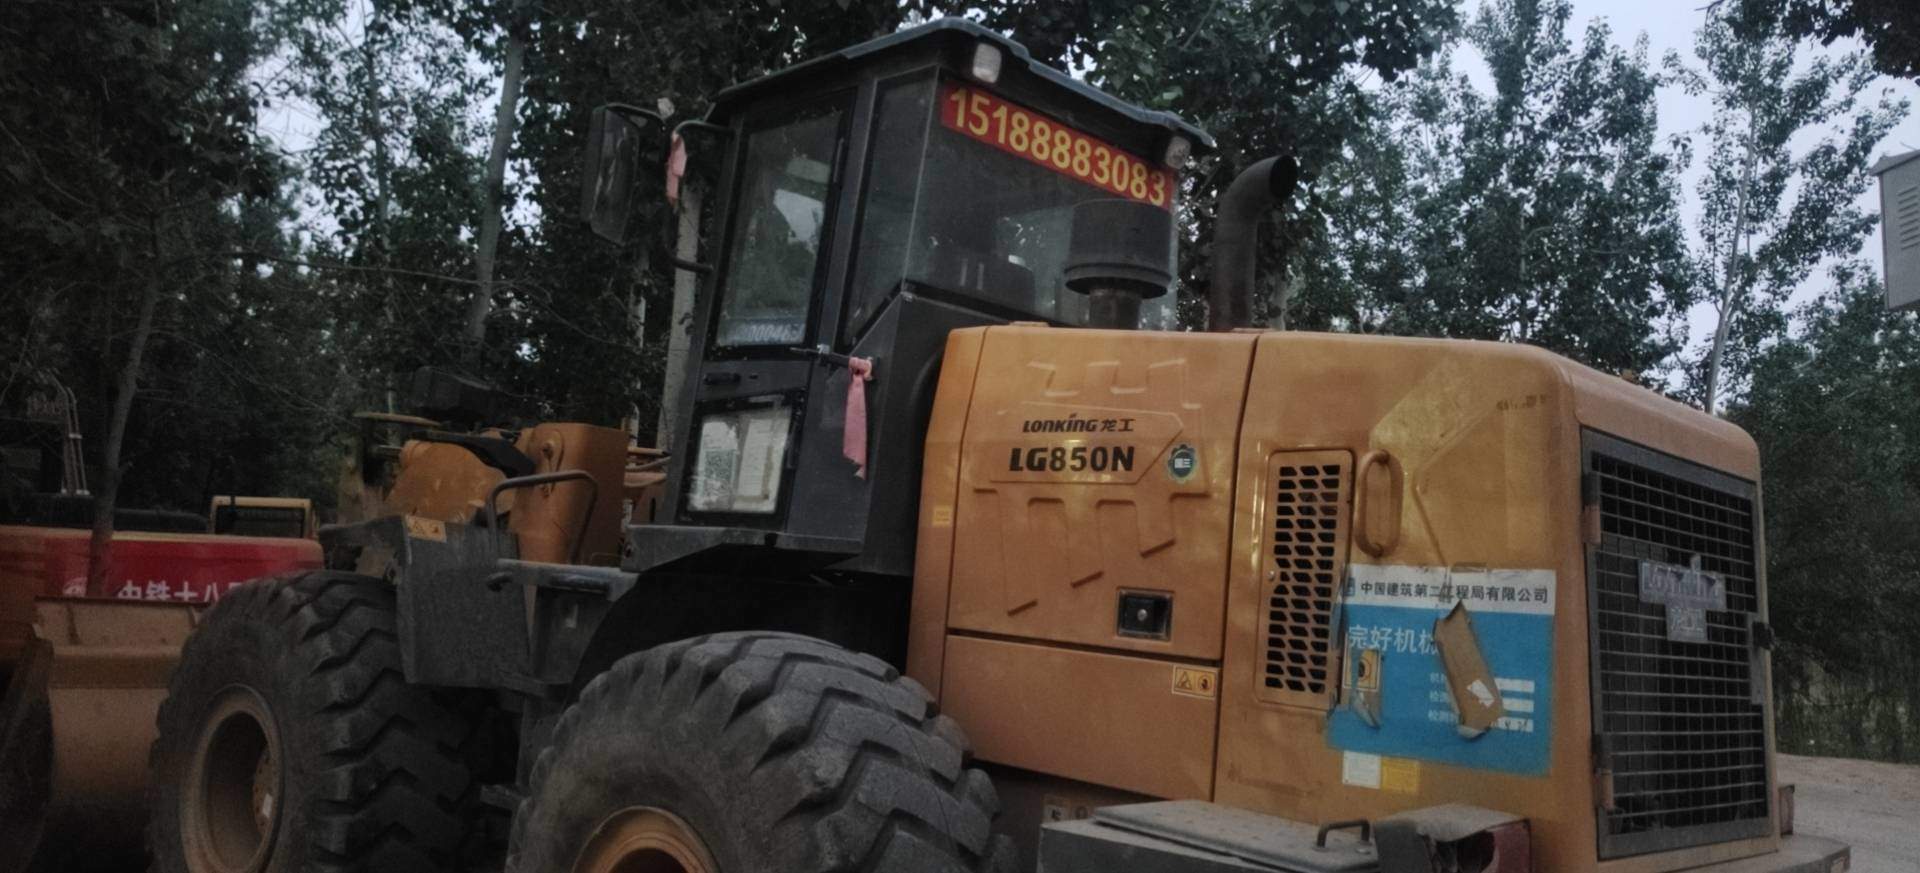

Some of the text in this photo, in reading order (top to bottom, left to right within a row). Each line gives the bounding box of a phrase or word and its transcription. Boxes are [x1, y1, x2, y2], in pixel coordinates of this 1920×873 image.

[951, 88, 1165, 206] 15188883083
[1101, 418, 1135, 433] 龙工
[1009, 446, 1135, 472] LG850N
[117, 579, 243, 602] 中铁十八
[1360, 582, 1549, 604] 中国建筑第二工程局有限公司
